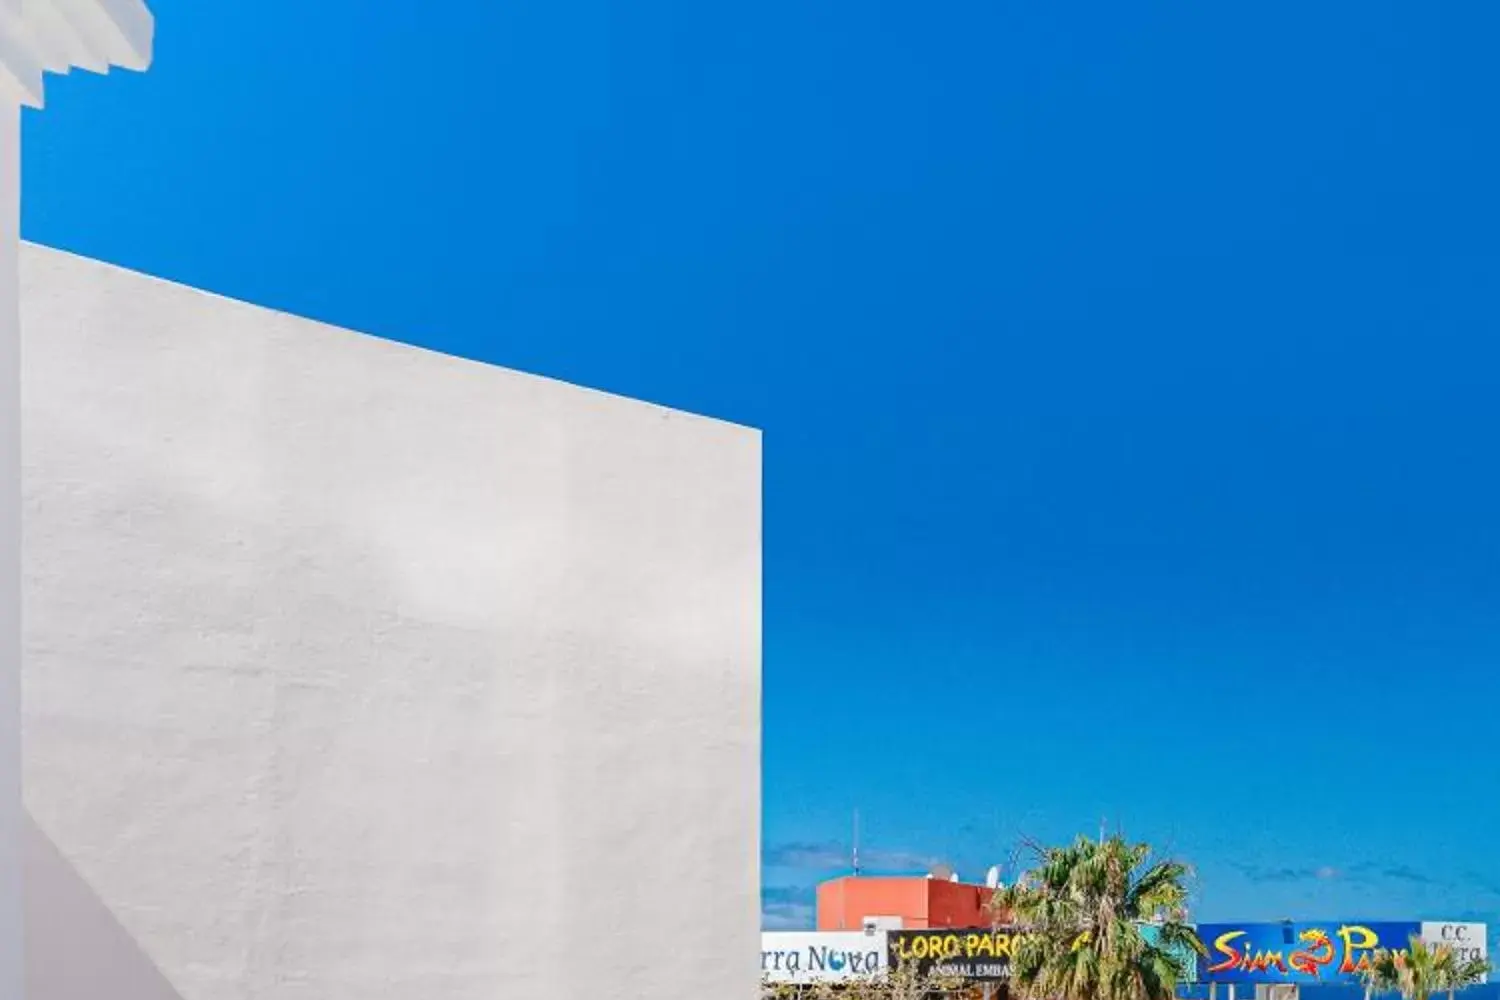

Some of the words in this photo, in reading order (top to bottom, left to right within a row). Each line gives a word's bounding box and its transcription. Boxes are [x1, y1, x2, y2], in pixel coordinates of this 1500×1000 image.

[760, 950, 801, 971] rra
[808, 945, 879, 974] Nova
[899, 934, 959, 959] LORO
